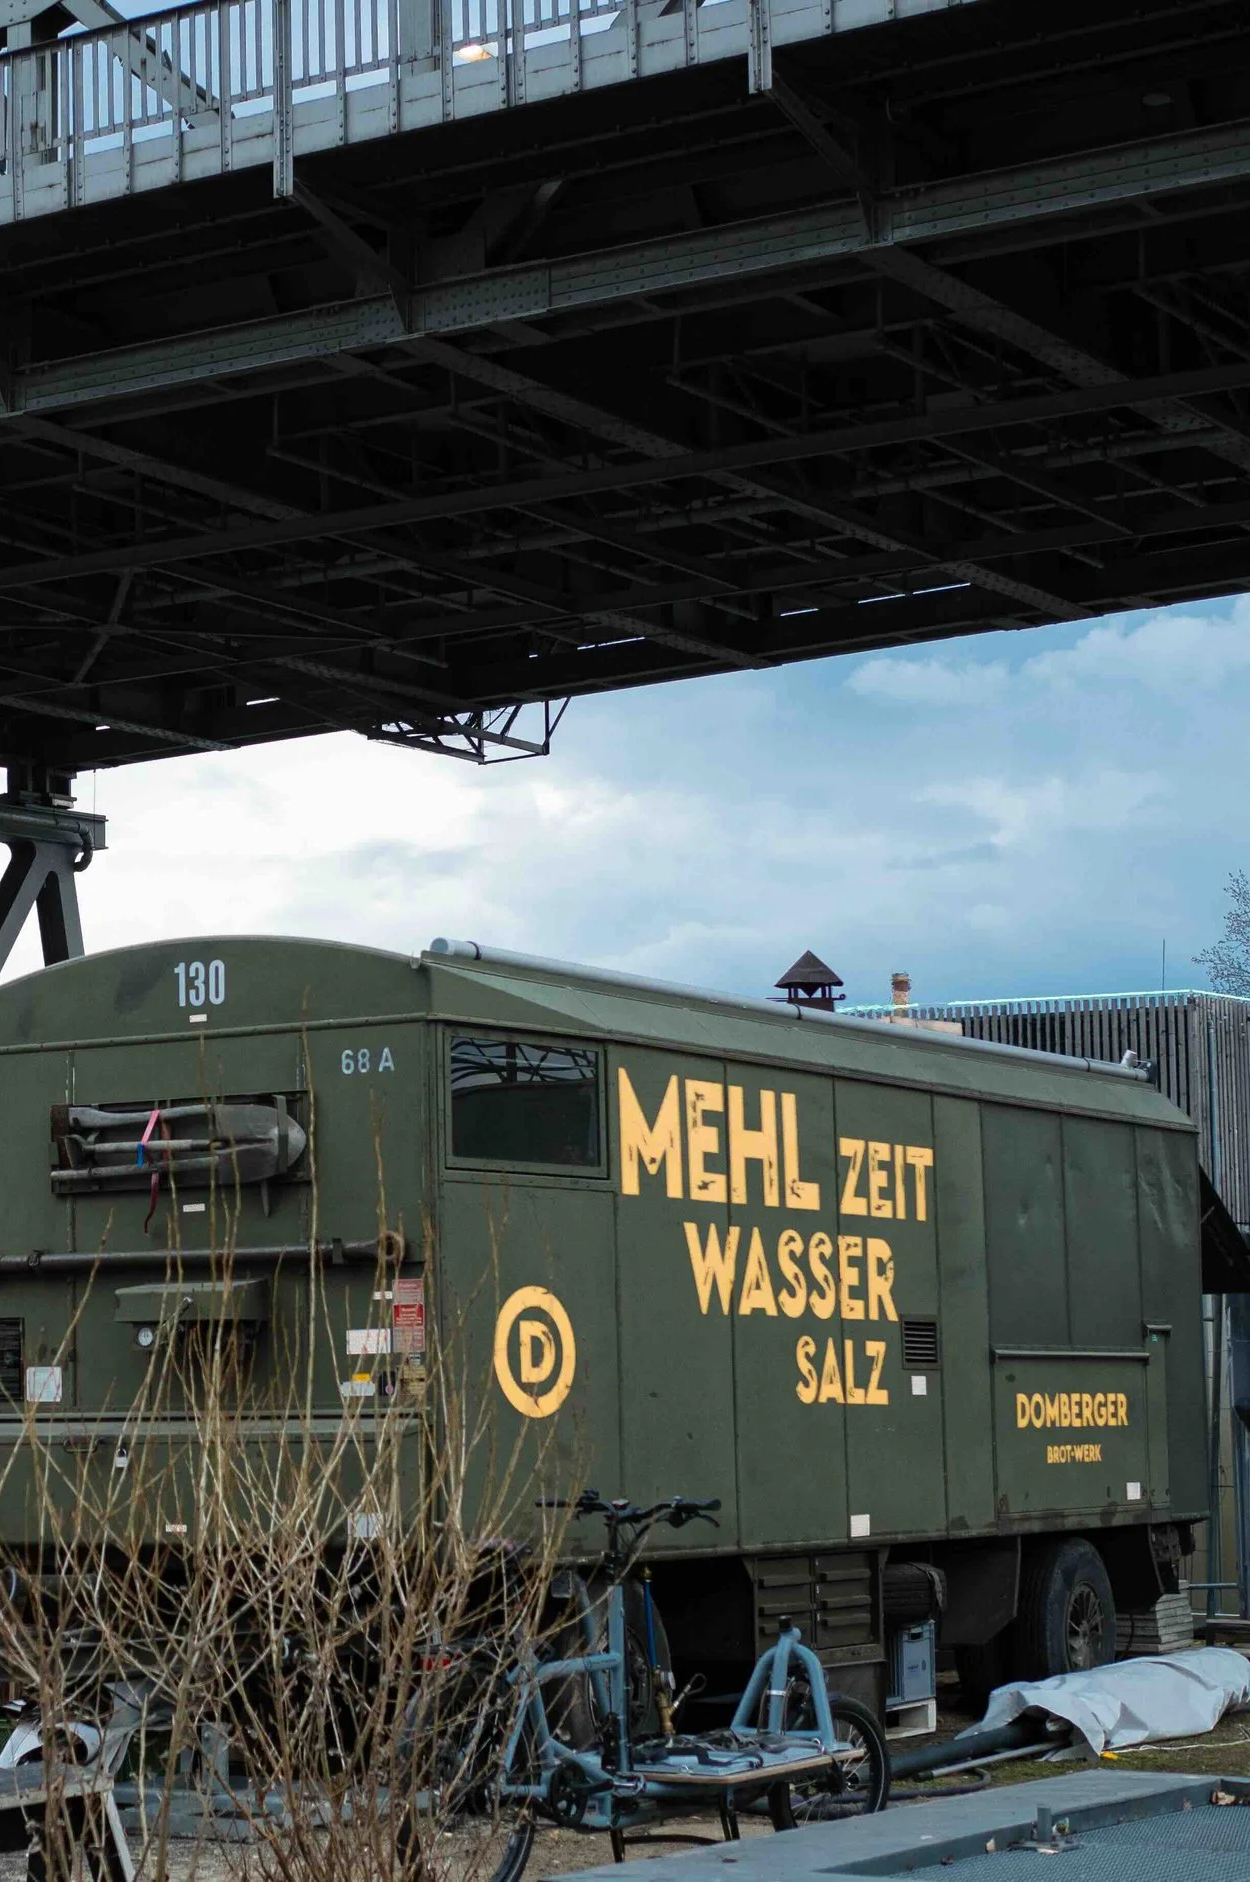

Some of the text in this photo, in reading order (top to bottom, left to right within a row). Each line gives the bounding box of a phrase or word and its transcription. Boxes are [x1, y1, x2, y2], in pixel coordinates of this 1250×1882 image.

[174, 959, 226, 1007] 130
[341, 1047, 395, 1075] 68 A
[618, 1067, 934, 1222] MEHL ZEIT
[683, 1221, 899, 1322] WASSER
[796, 1335, 889, 1405] SALZ
[1016, 1392, 1129, 1429] DOMBERGER
[1046, 1444, 1102, 1464] BROT-WERK
